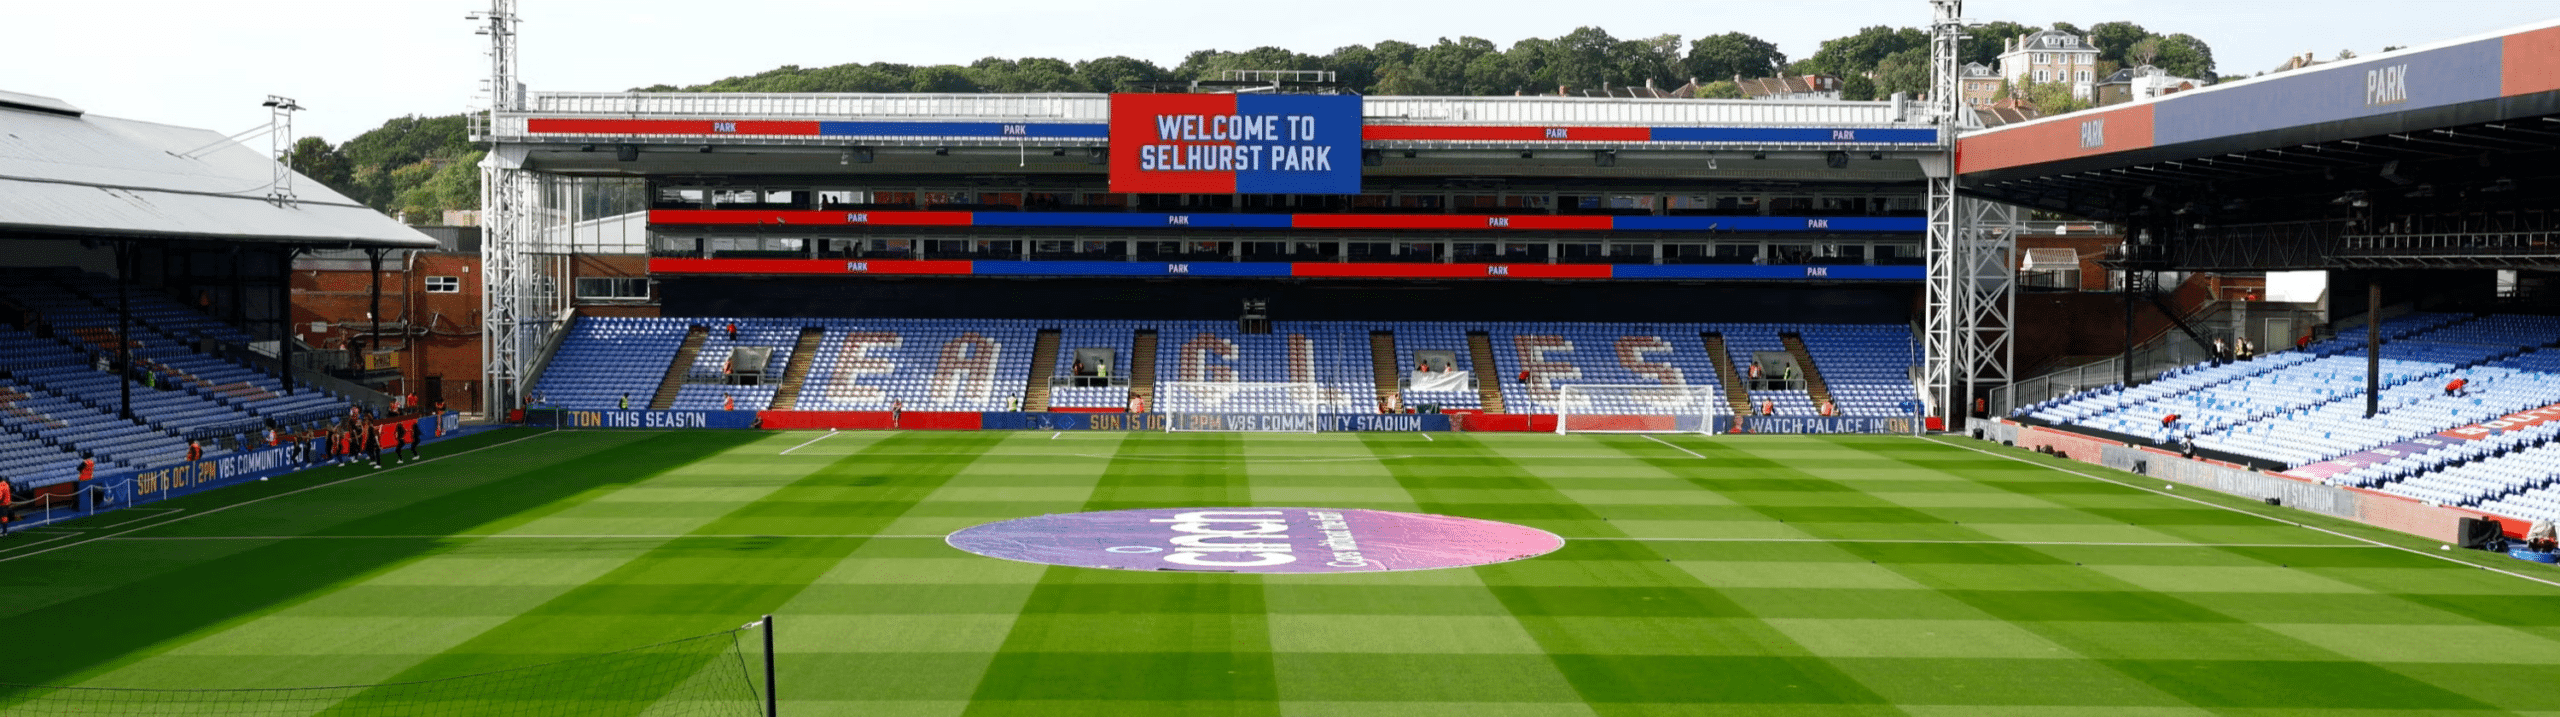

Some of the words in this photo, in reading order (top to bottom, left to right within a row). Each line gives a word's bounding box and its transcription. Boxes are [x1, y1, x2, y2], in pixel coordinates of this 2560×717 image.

[2367, 63, 2408, 105] PARK
[713, 122, 736, 133] PARK
[1003, 124, 1026, 135] PARK
[1157, 114, 1279, 141] WELCOME
[1287, 115, 1315, 141] TO
[1546, 128, 1568, 139] PARK
[2081, 119, 2104, 148] PARK
[1832, 130, 1855, 140] PARK
[1141, 144, 1263, 171] SELHURST
[1271, 145, 1332, 171] PARK
[848, 213, 867, 222] PARK
[1169, 215, 1189, 225] PARK
[1489, 217, 1509, 227] PARK
[1808, 219, 1828, 228] PARK
[848, 261, 867, 271] PARK
[1168, 263, 1189, 274] PARK
[1488, 266, 1508, 276] PARK
[1807, 267, 1827, 277] PARK
[606, 411, 640, 428] THIS
[645, 411, 706, 428] SEASON
[1090, 414, 1120, 431] SUN
[1126, 414, 1141, 431] 15
[1190, 414, 1221, 431] 2PM
[1227, 415, 1256, 431] VBS
[1357, 415, 1421, 431] STADIUM
[1750, 418, 1801, 434] WATCH
[1807, 418, 1863, 434] PALACE
[1869, 418, 1884, 434] IN
[218, 456, 235, 479] VBS
[237, 447, 284, 475] COMMUNITY
[137, 471, 158, 496] SUN
[173, 465, 190, 488] OCT
[198, 460, 216, 483] 2PM
[2236, 472, 2289, 503] COMMUNITY
[2292, 482, 2334, 513] STADIUM
[1150, 511, 1297, 566] cinch
